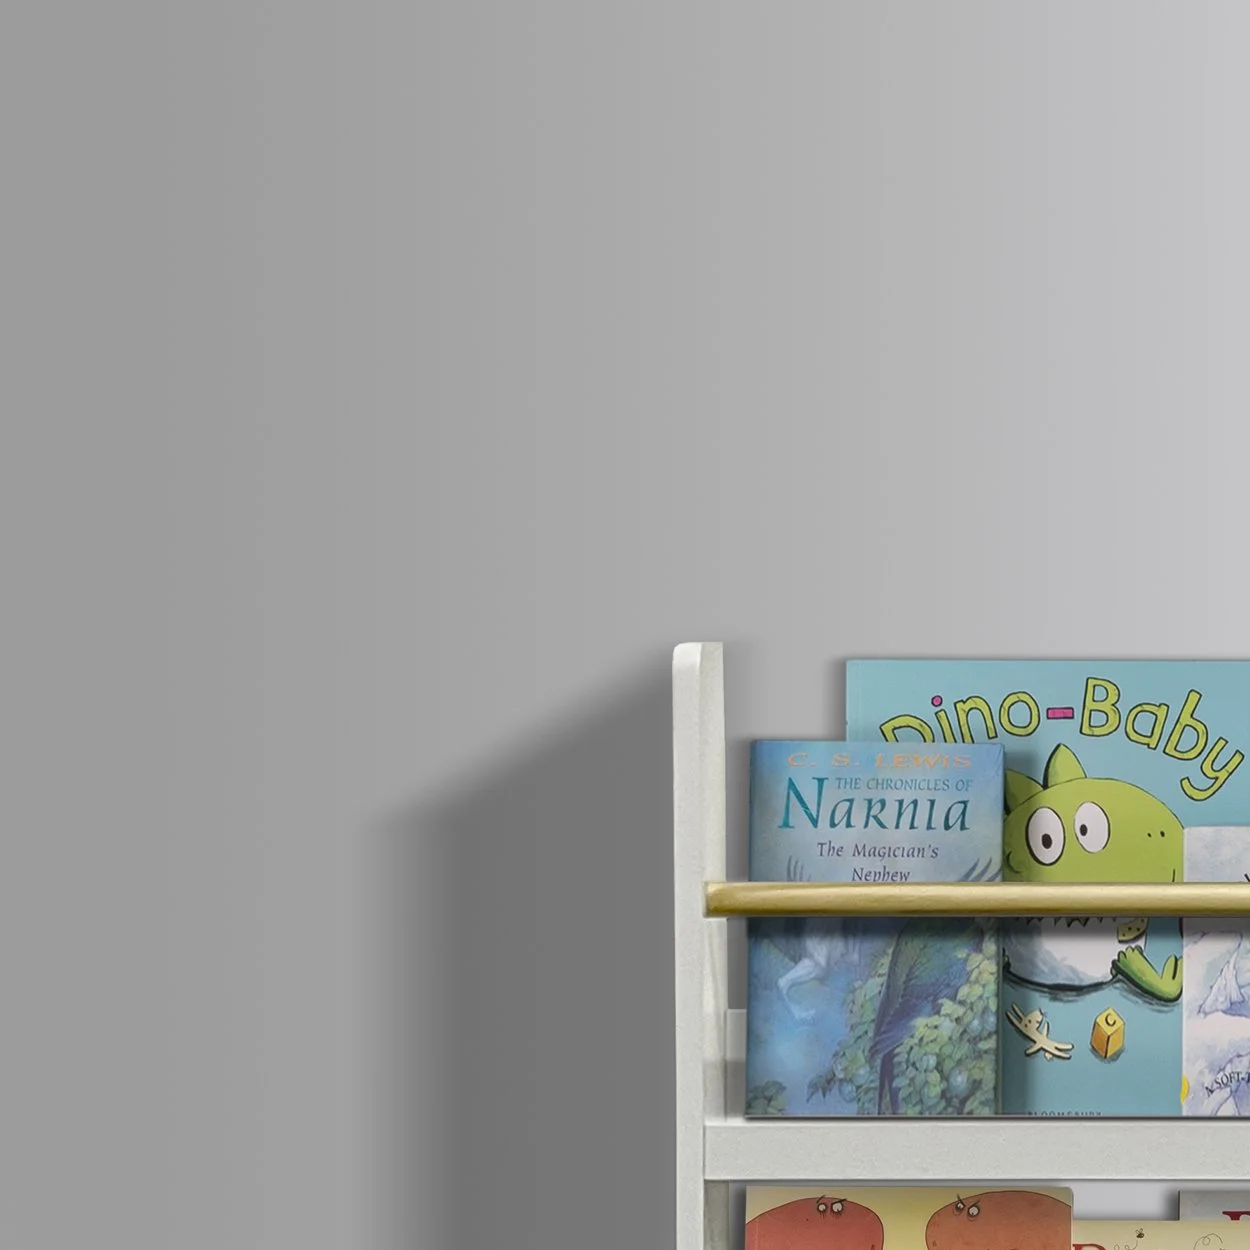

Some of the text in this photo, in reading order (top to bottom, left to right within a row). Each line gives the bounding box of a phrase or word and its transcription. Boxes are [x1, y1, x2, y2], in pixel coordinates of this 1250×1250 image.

[879, 677, 1245, 801] Dino-Baby
[876, 753, 972, 769] LEWIS
[836, 777, 973, 791] THE CHRONICLES OF
[817, 840, 939, 862] The Magician's
[851, 866, 910, 882] Nephew
[1205, 1085, 1215, 1098] A
